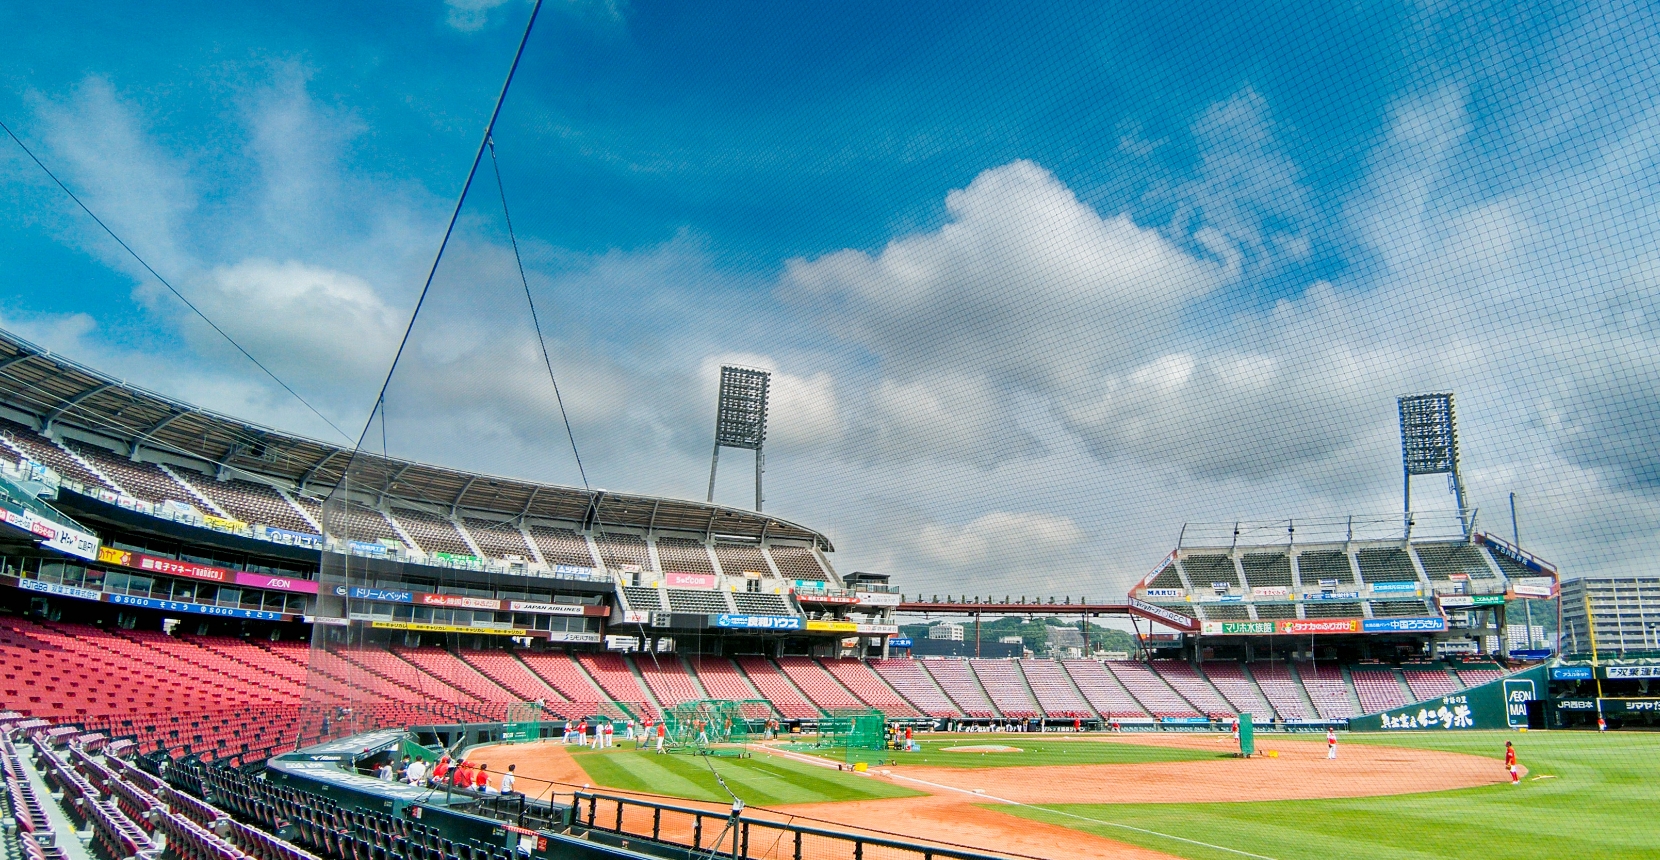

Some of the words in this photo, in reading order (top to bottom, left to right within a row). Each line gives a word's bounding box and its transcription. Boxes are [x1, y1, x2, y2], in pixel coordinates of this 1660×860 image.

[356, 588, 409, 601] ドリームベッド
[124, 596, 149, 606] SOGO
[209, 607, 234, 615] SOGO
[1224, 622, 1272, 633] マリホ水族館
[1390, 619, 1442, 629] 中国ろうきん
[1557, 701, 1594, 709] JR西日本
